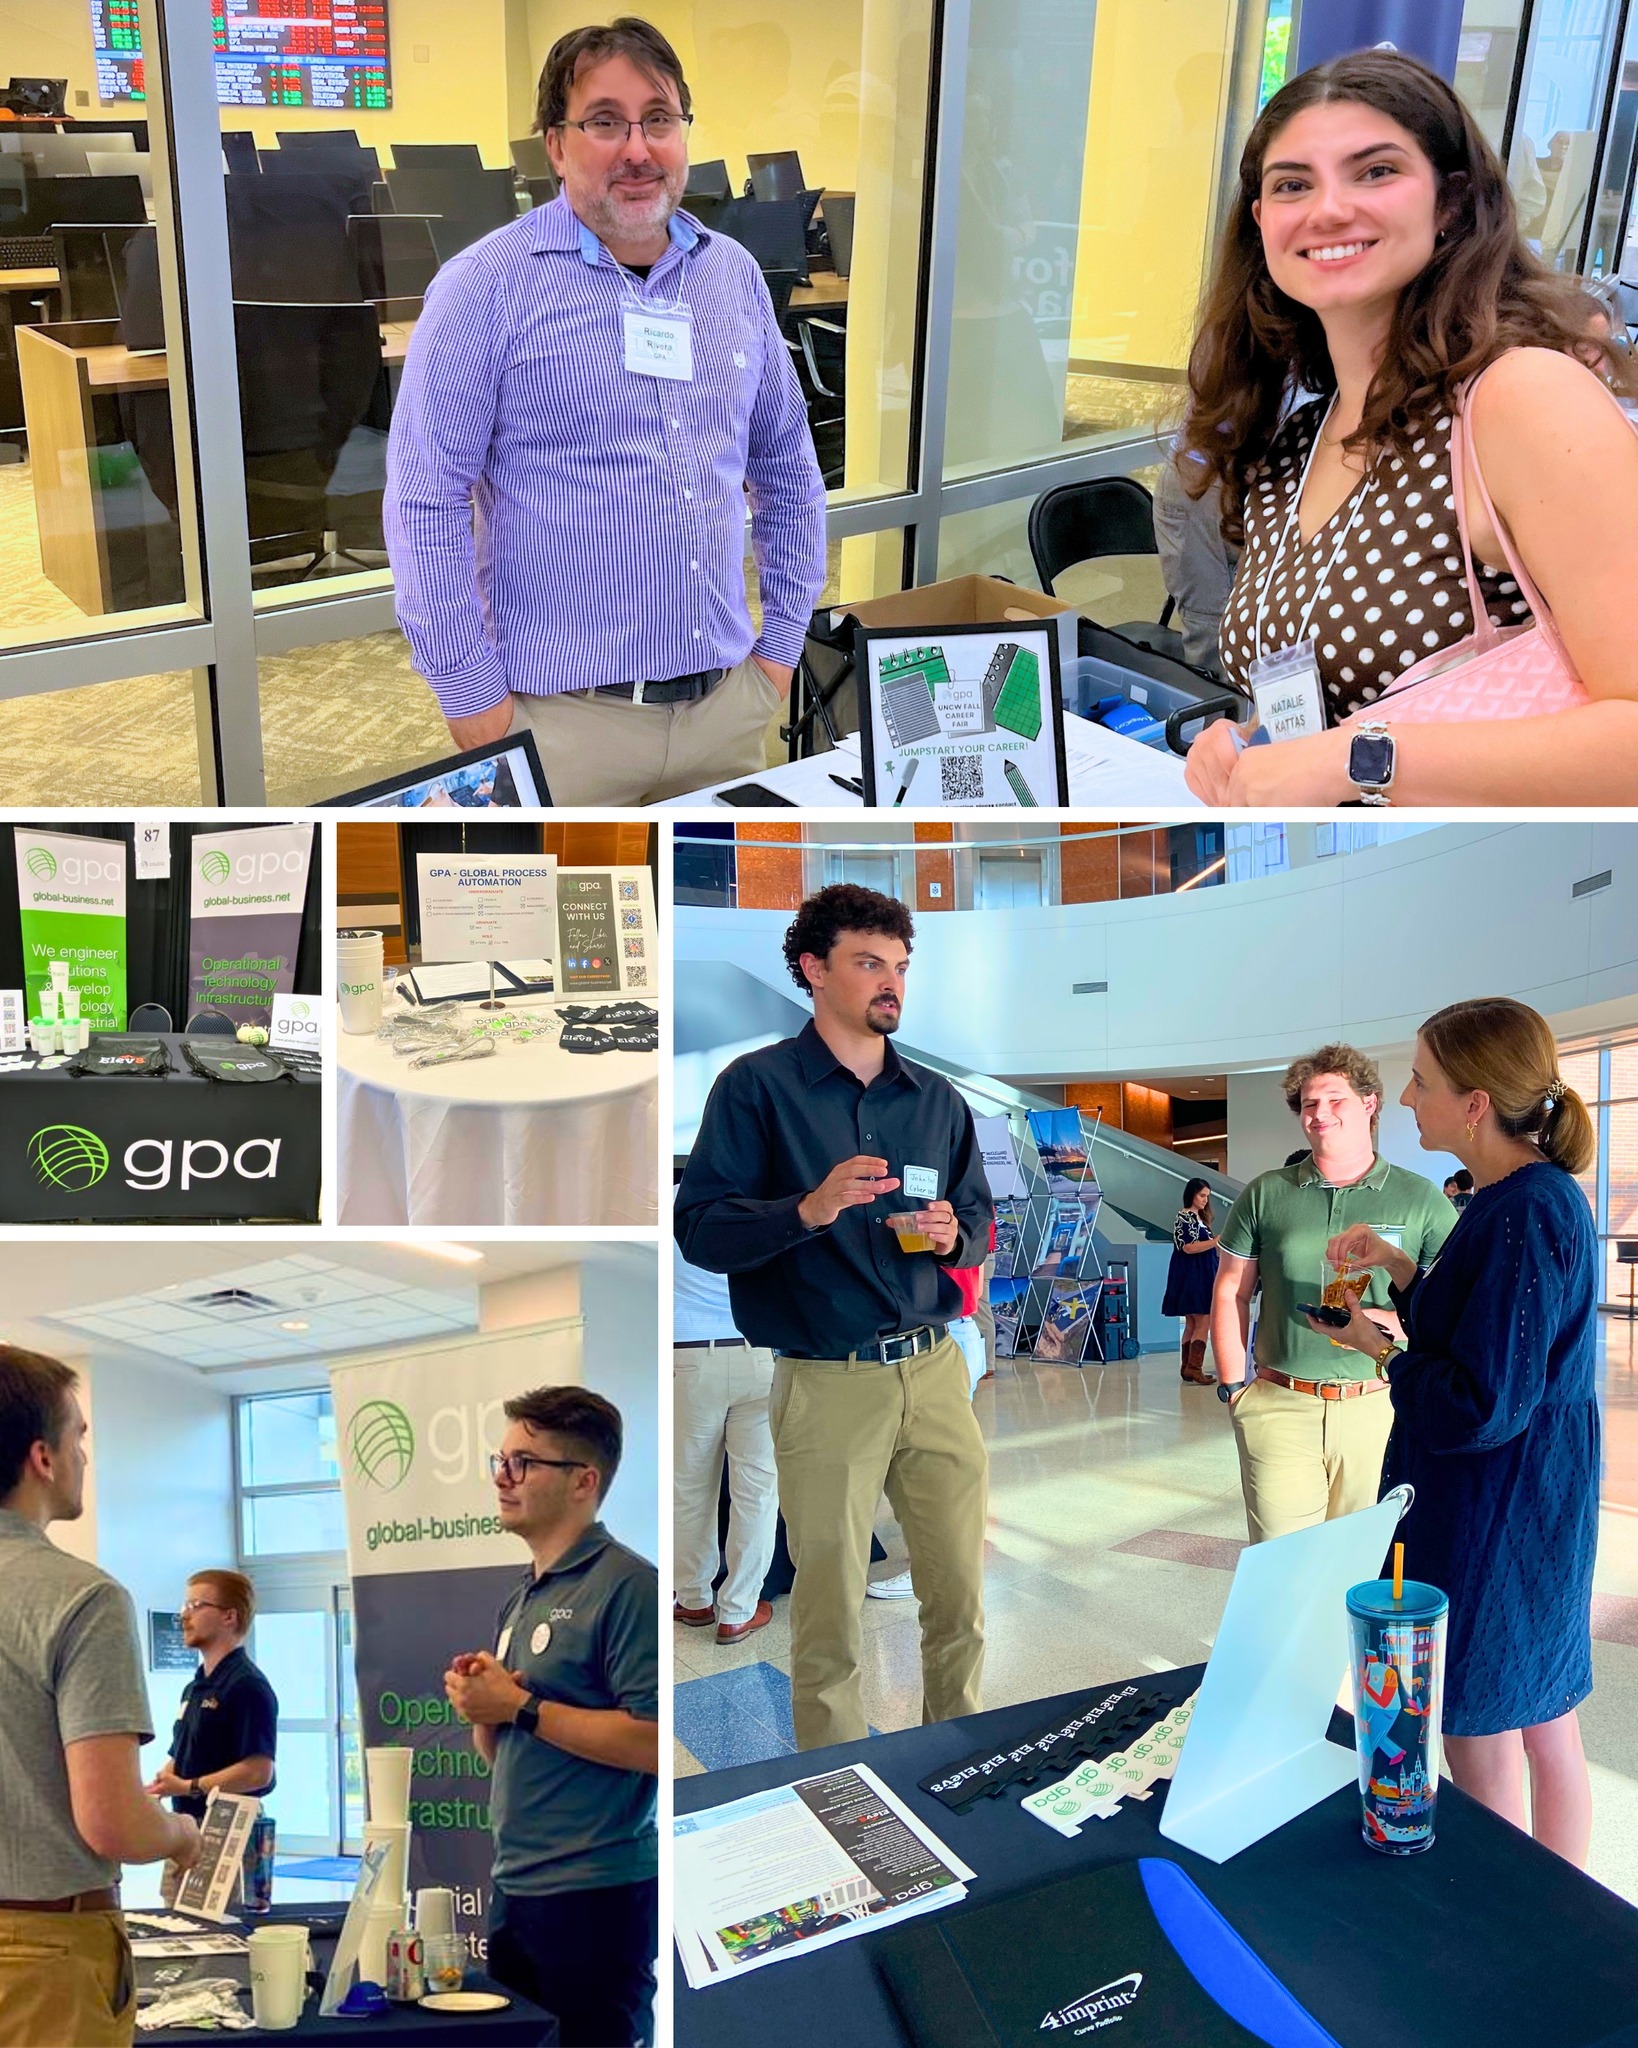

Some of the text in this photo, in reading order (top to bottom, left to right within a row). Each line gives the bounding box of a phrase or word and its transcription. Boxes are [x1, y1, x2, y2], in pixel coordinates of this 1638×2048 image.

[644, 327, 675, 340] Ricardo
[953, 690, 973, 701] gpa
[938, 703, 962, 711] UNCW
[1271, 694, 1305, 714] NATALIE
[1275, 715, 1306, 732] KATTAS
[899, 741, 1029, 757] JUMPSTART YOUR CAREER!
[144, 829, 160, 842] 87
[63, 856, 121, 885] gpa
[236, 849, 305, 885] gpa
[429, 869, 451, 877] GPA
[460, 869, 500, 877] GLOBAL
[502, 869, 547, 877] PROCESS
[458, 878, 521, 886] AUTOMATION
[579, 882, 600, 892] gpa
[33, 891, 114, 906] global-business.net
[203, 892, 291, 908] global-business.net
[562, 902, 608, 911] CONNECT
[566, 912, 606, 921] WITH US
[32, 944, 118, 961] We engineer
[48, 965, 106, 977] sutions
[202, 957, 281, 974] Operational
[68, 982, 111, 996] evelop
[203, 976, 278, 990] Technology
[350, 982, 374, 996] gpa
[196, 991, 273, 1006] Infrastructur
[278, 1018, 318, 1034] gpa
[532, 1025, 555, 1036] gpa
[99, 1056, 146, 1064] Elev8
[236, 1061, 268, 1071] gpa
[124, 1138, 281, 1190] gpa
[428, 1399, 504, 1484] gp
[366, 1512, 505, 1550] global-busines
[550, 1607, 572, 1621] gpa
[1100, 1693, 1122, 1710] Ele
[1082, 1707, 1104, 1723] Ele
[1060, 1719, 1084, 1737] Ele
[1151, 1725, 1173, 1744] gp
[1035, 1732, 1060, 1751] Ele
[1008, 1743, 1035, 1762] Ele
[1133, 1743, 1154, 1760] gp
[979, 1753, 1008, 1774] Ele
[833, 1780, 861, 1790] CONTACT
[930, 1765, 982, 1793] Elev8
[1075, 1767, 1099, 1788] gp
[1032, 1785, 1071, 1808] gpa
[819, 1800, 853, 1813] LOCATIONS
[857, 1809, 890, 1823] Elev8
[864, 1817, 896, 1829] PRODUCTS
[920, 1863, 940, 1874] ABOUT
[831, 1875, 861, 1887] SERVICES
[895, 1880, 933, 1901] gpa
[1040, 1991, 1134, 2030] 4imprint
[1074, 2024, 1095, 2036] Curve
